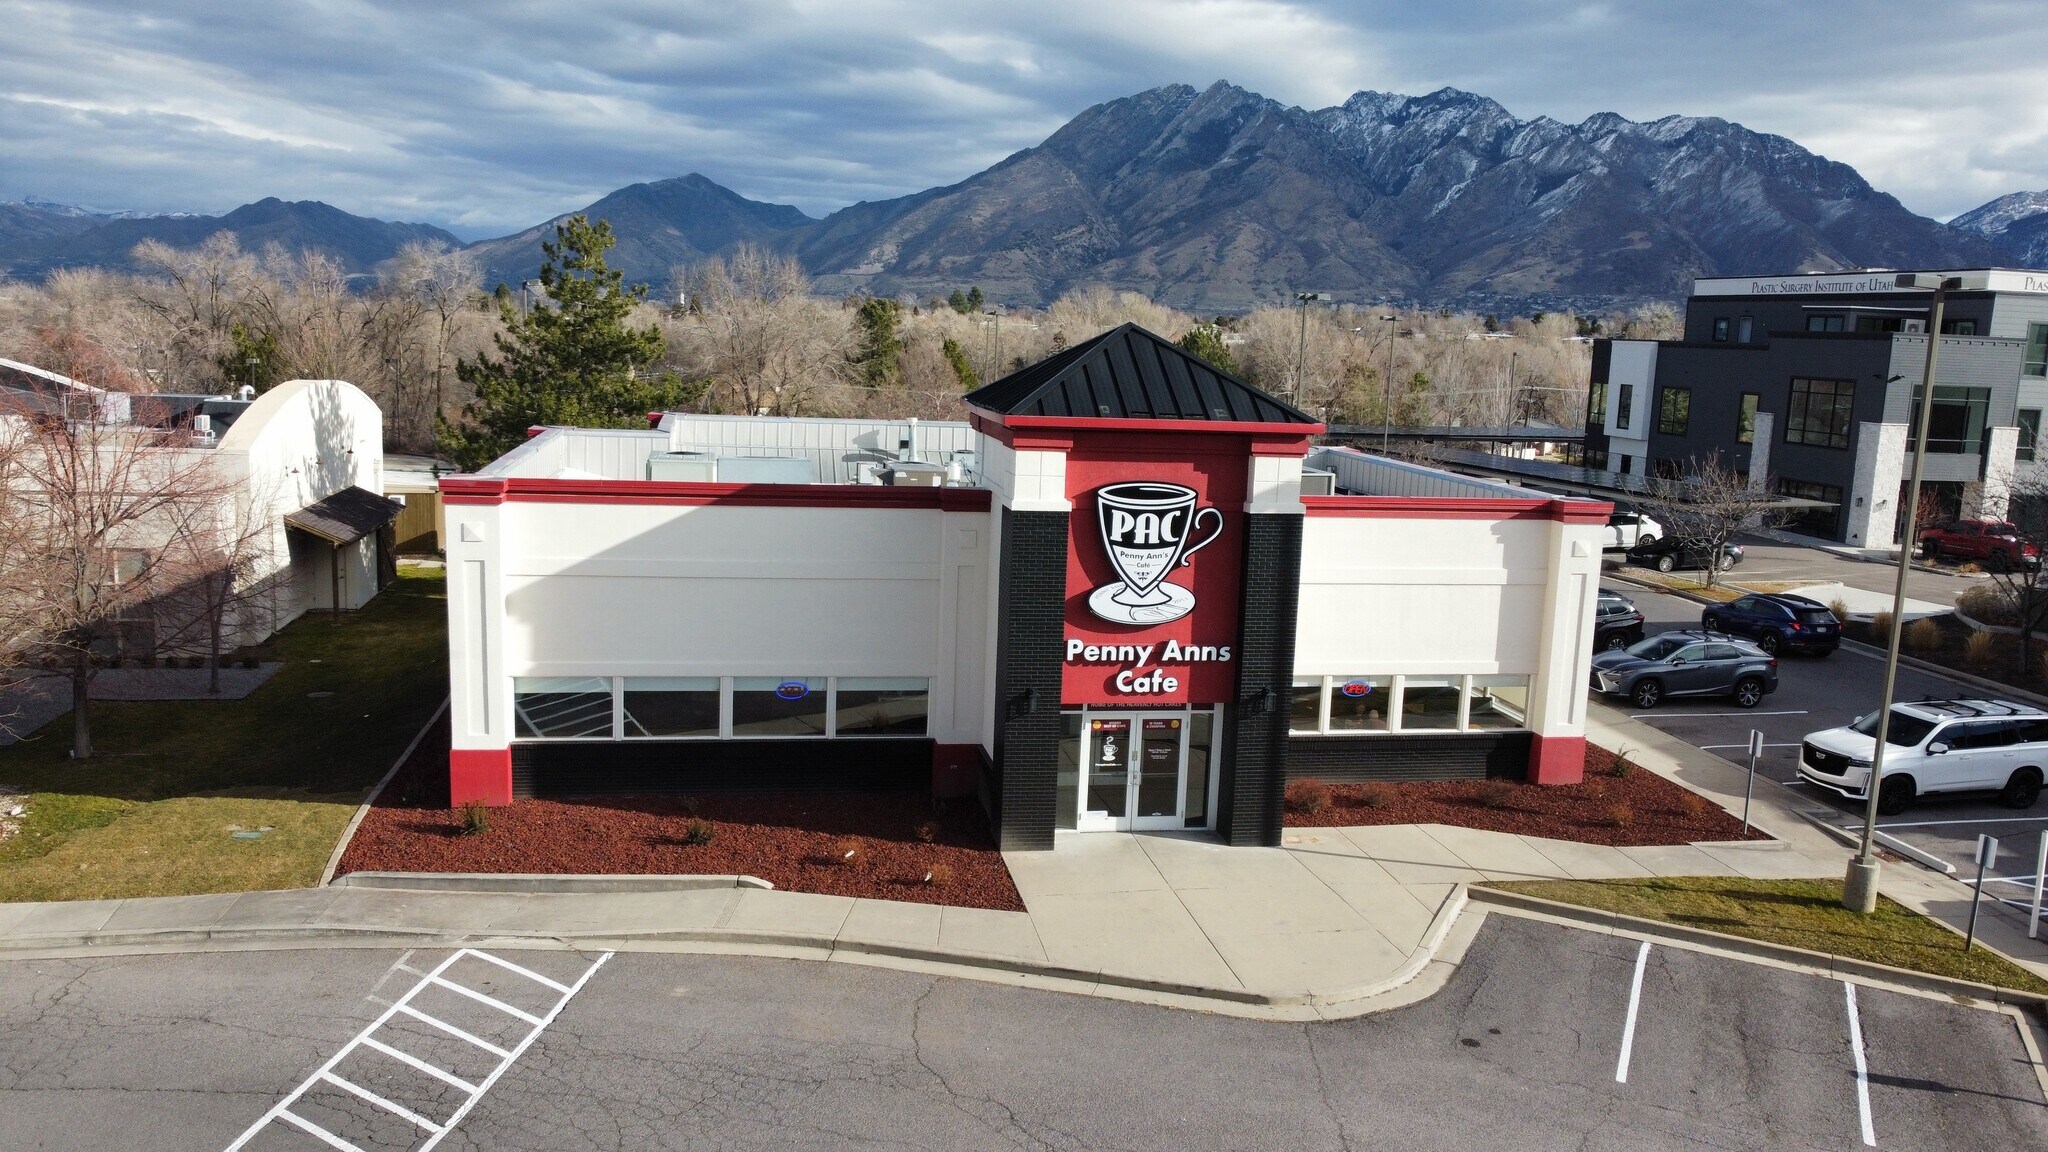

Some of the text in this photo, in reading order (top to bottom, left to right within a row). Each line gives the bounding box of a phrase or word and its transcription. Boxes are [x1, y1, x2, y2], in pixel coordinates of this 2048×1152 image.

[1752, 281, 1778, 293] PLASTIC
[1780, 281, 1813, 292] SURGERY
[1815, 280, 1854, 292] INSTITUTE
[1869, 279, 1893, 291] UTAH
[1110, 510, 1180, 544] PAC
[1120, 550, 1145, 560] Penny
[1066, 639, 1231, 667] Penny Anns
[1116, 669, 1178, 692] Cafe
[1345, 684, 1368, 694] OPEN
